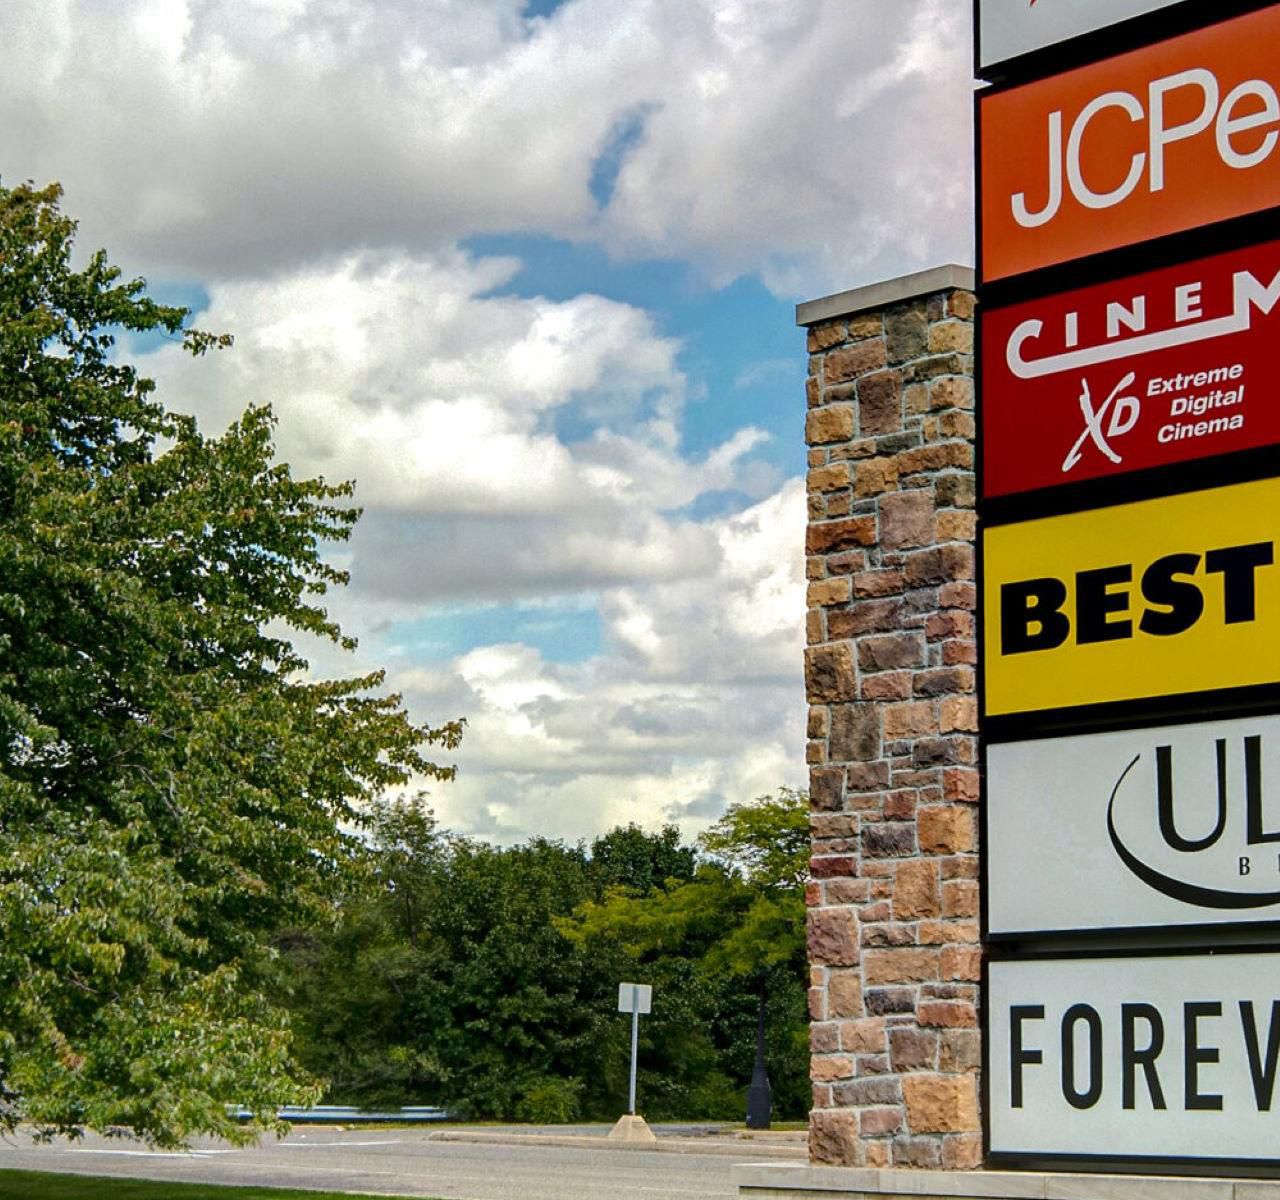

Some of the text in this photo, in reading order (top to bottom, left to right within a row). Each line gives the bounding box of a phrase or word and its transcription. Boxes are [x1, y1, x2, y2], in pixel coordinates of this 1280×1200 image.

[1147, 363, 1244, 397] Extreme
[1170, 385, 1245, 416] Digital
[1062, 371, 1141, 472] XD
[1157, 413, 1244, 443] Cinema
[1000, 541, 1273, 656] BEST
